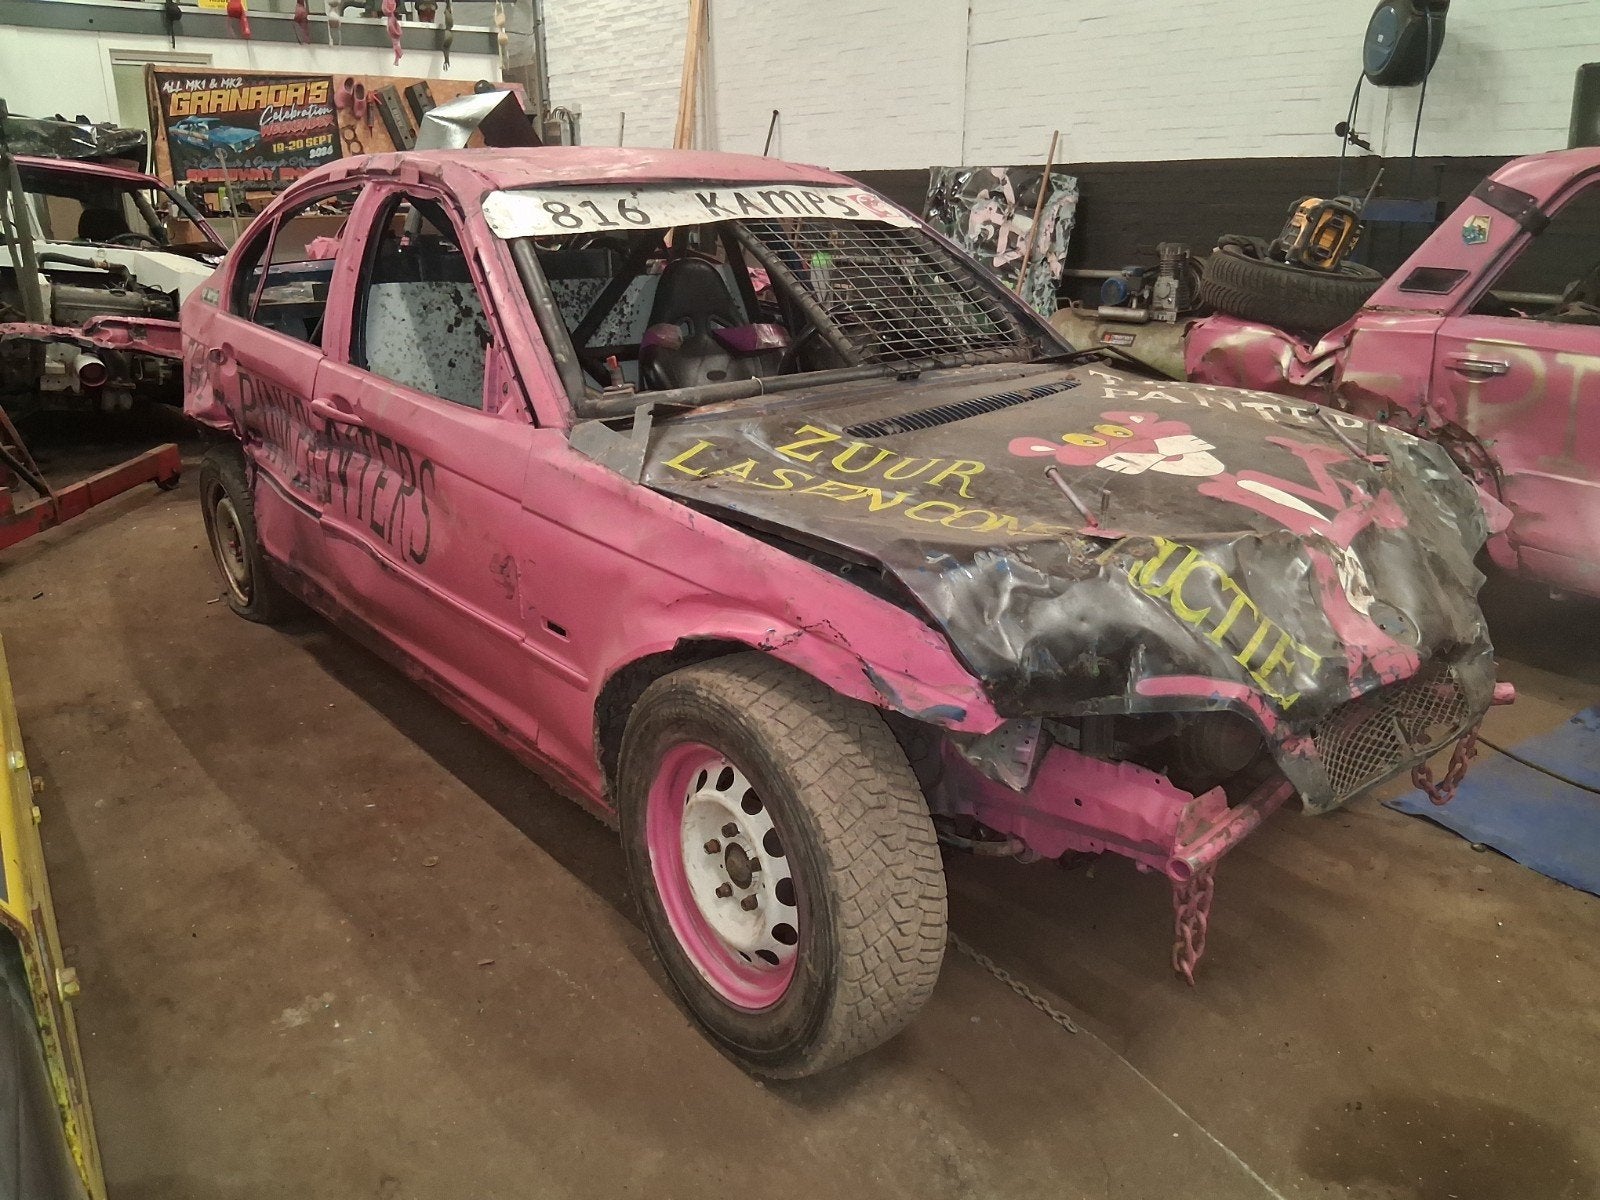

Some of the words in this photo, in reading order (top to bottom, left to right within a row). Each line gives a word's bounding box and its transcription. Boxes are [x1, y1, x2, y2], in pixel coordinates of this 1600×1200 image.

[163, 81, 182, 93] ALL
[186, 79, 206, 91] MK1
[209, 78, 218, 89] &
[221, 77, 243, 89] MK2
[169, 81, 329, 116] GRANADA'S
[259, 102, 334, 126] Celebration
[305, 134, 333, 148] SEPT
[542, 197, 651, 229] 816
[694, 190, 860, 217] KAMPS
[774, 424, 985, 499] ZUUR
